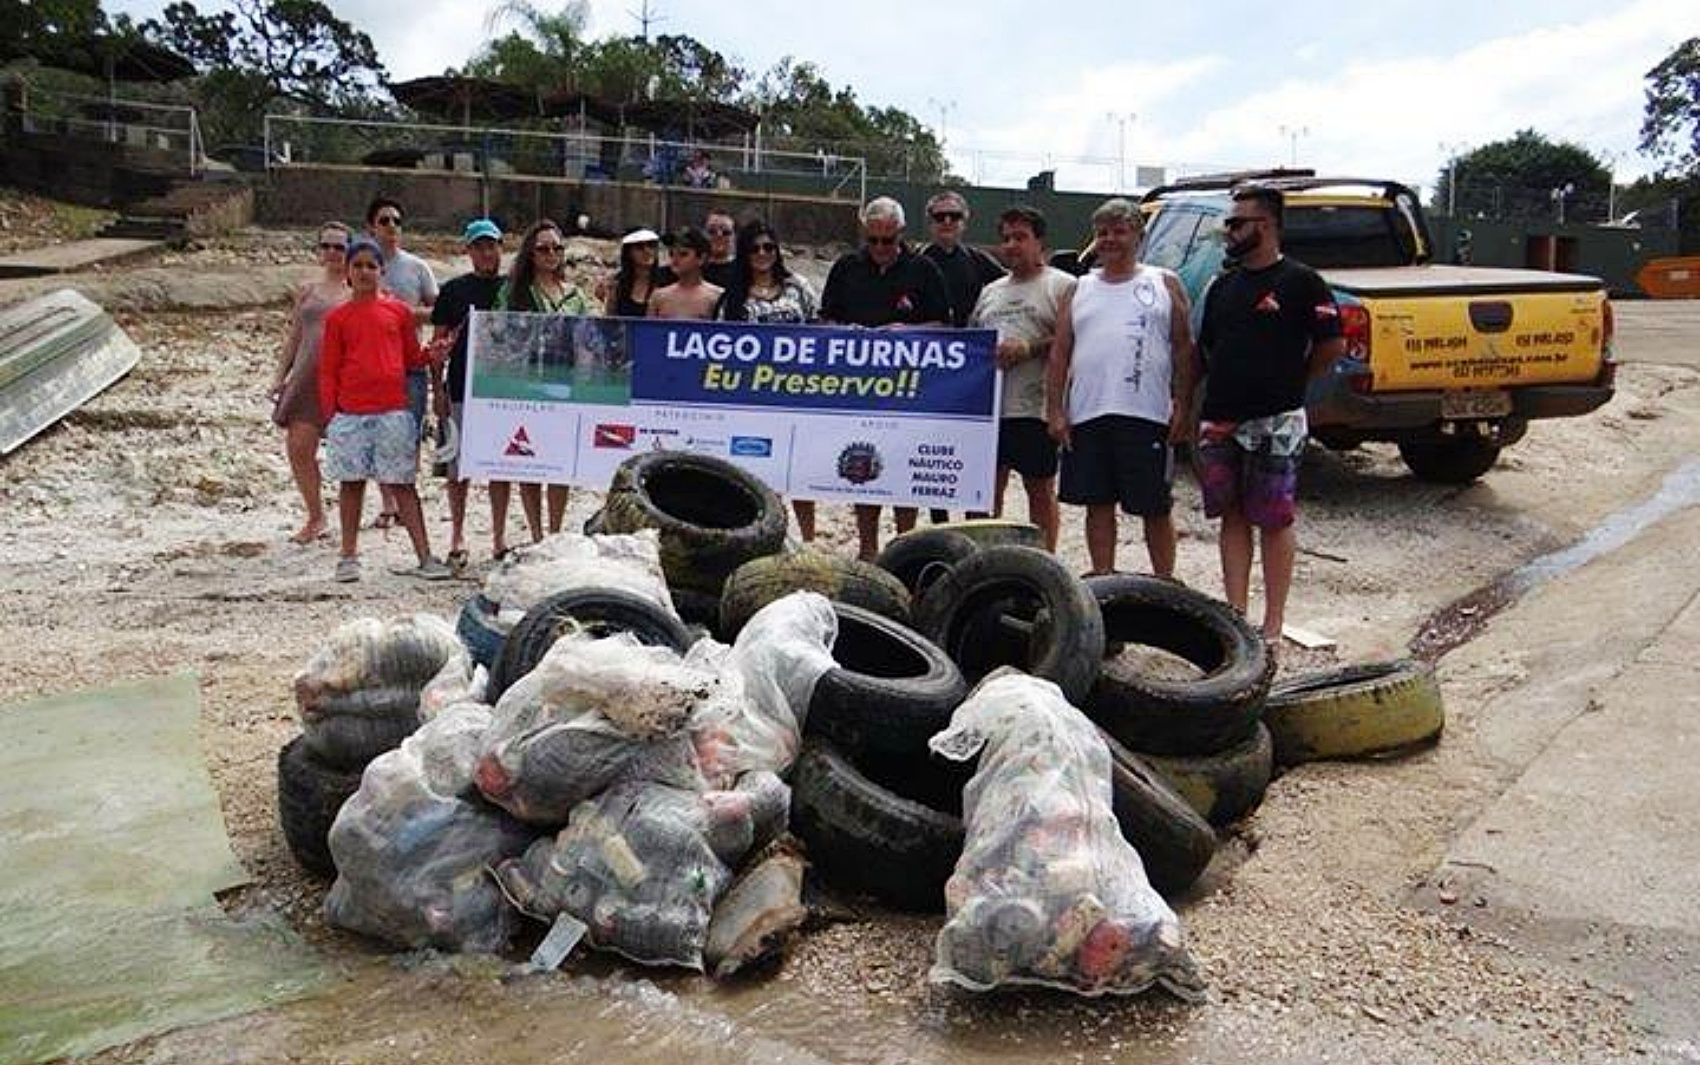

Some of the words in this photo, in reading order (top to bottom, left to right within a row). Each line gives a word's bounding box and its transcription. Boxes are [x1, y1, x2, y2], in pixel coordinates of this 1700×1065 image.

[667, 331, 761, 361] LAGO
[773, 336, 816, 364] DE
[827, 338, 966, 369] FURNAS
[703, 363, 742, 390] Eu
[752, 364, 920, 398] Preservo!!
[917, 443, 955, 456] CLUBE
[911, 471, 959, 484] MAURO
